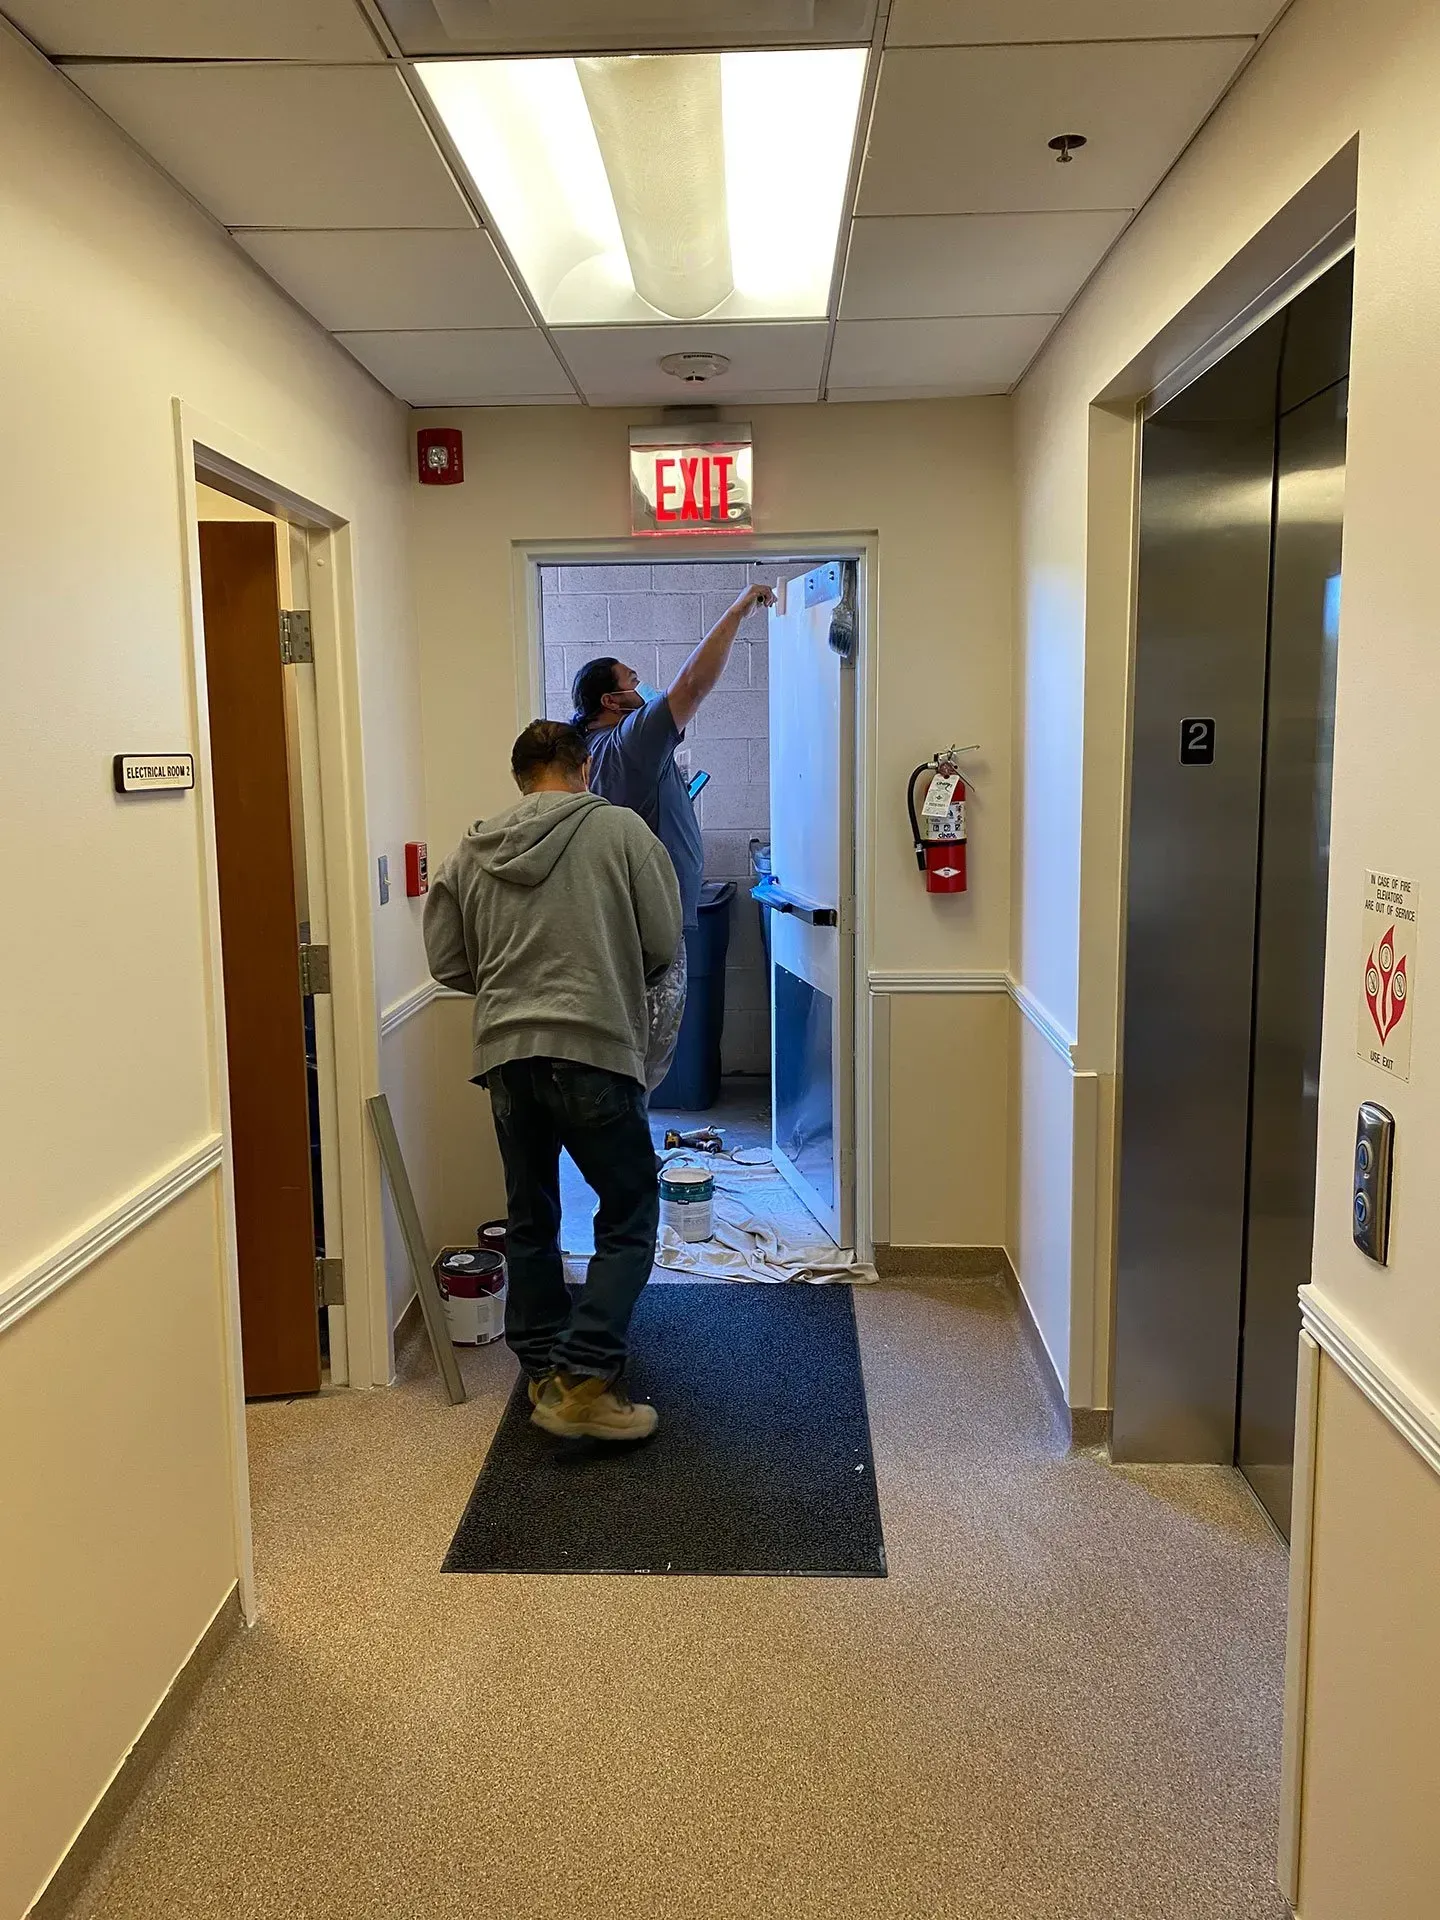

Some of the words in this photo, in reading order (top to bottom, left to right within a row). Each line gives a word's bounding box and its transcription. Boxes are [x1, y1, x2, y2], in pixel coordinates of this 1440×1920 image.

[655, 456, 733, 521] EXIT
[1188, 722, 1208, 750] 2
[126, 766, 166, 779] ELECTRICAL
[167, 765, 185, 777] ROOM
[186, 765, 190, 777] 2
[1370, 874, 1376, 885] IN
[1377, 875, 1390, 888] CASE
[1392, 878, 1398, 889] OF
[1400, 880, 1411, 893] FIRE
[1376, 888, 1404, 905] ELEVATORS
[1364, 899, 1374, 911] ARE
[1375, 901, 1385, 914] OUT
[1387, 904, 1393, 915] OF
[1395, 906, 1415, 922] SERVICE
[1370, 1050, 1381, 1065] USE
[1382, 1056, 1394, 1070] EXIT
